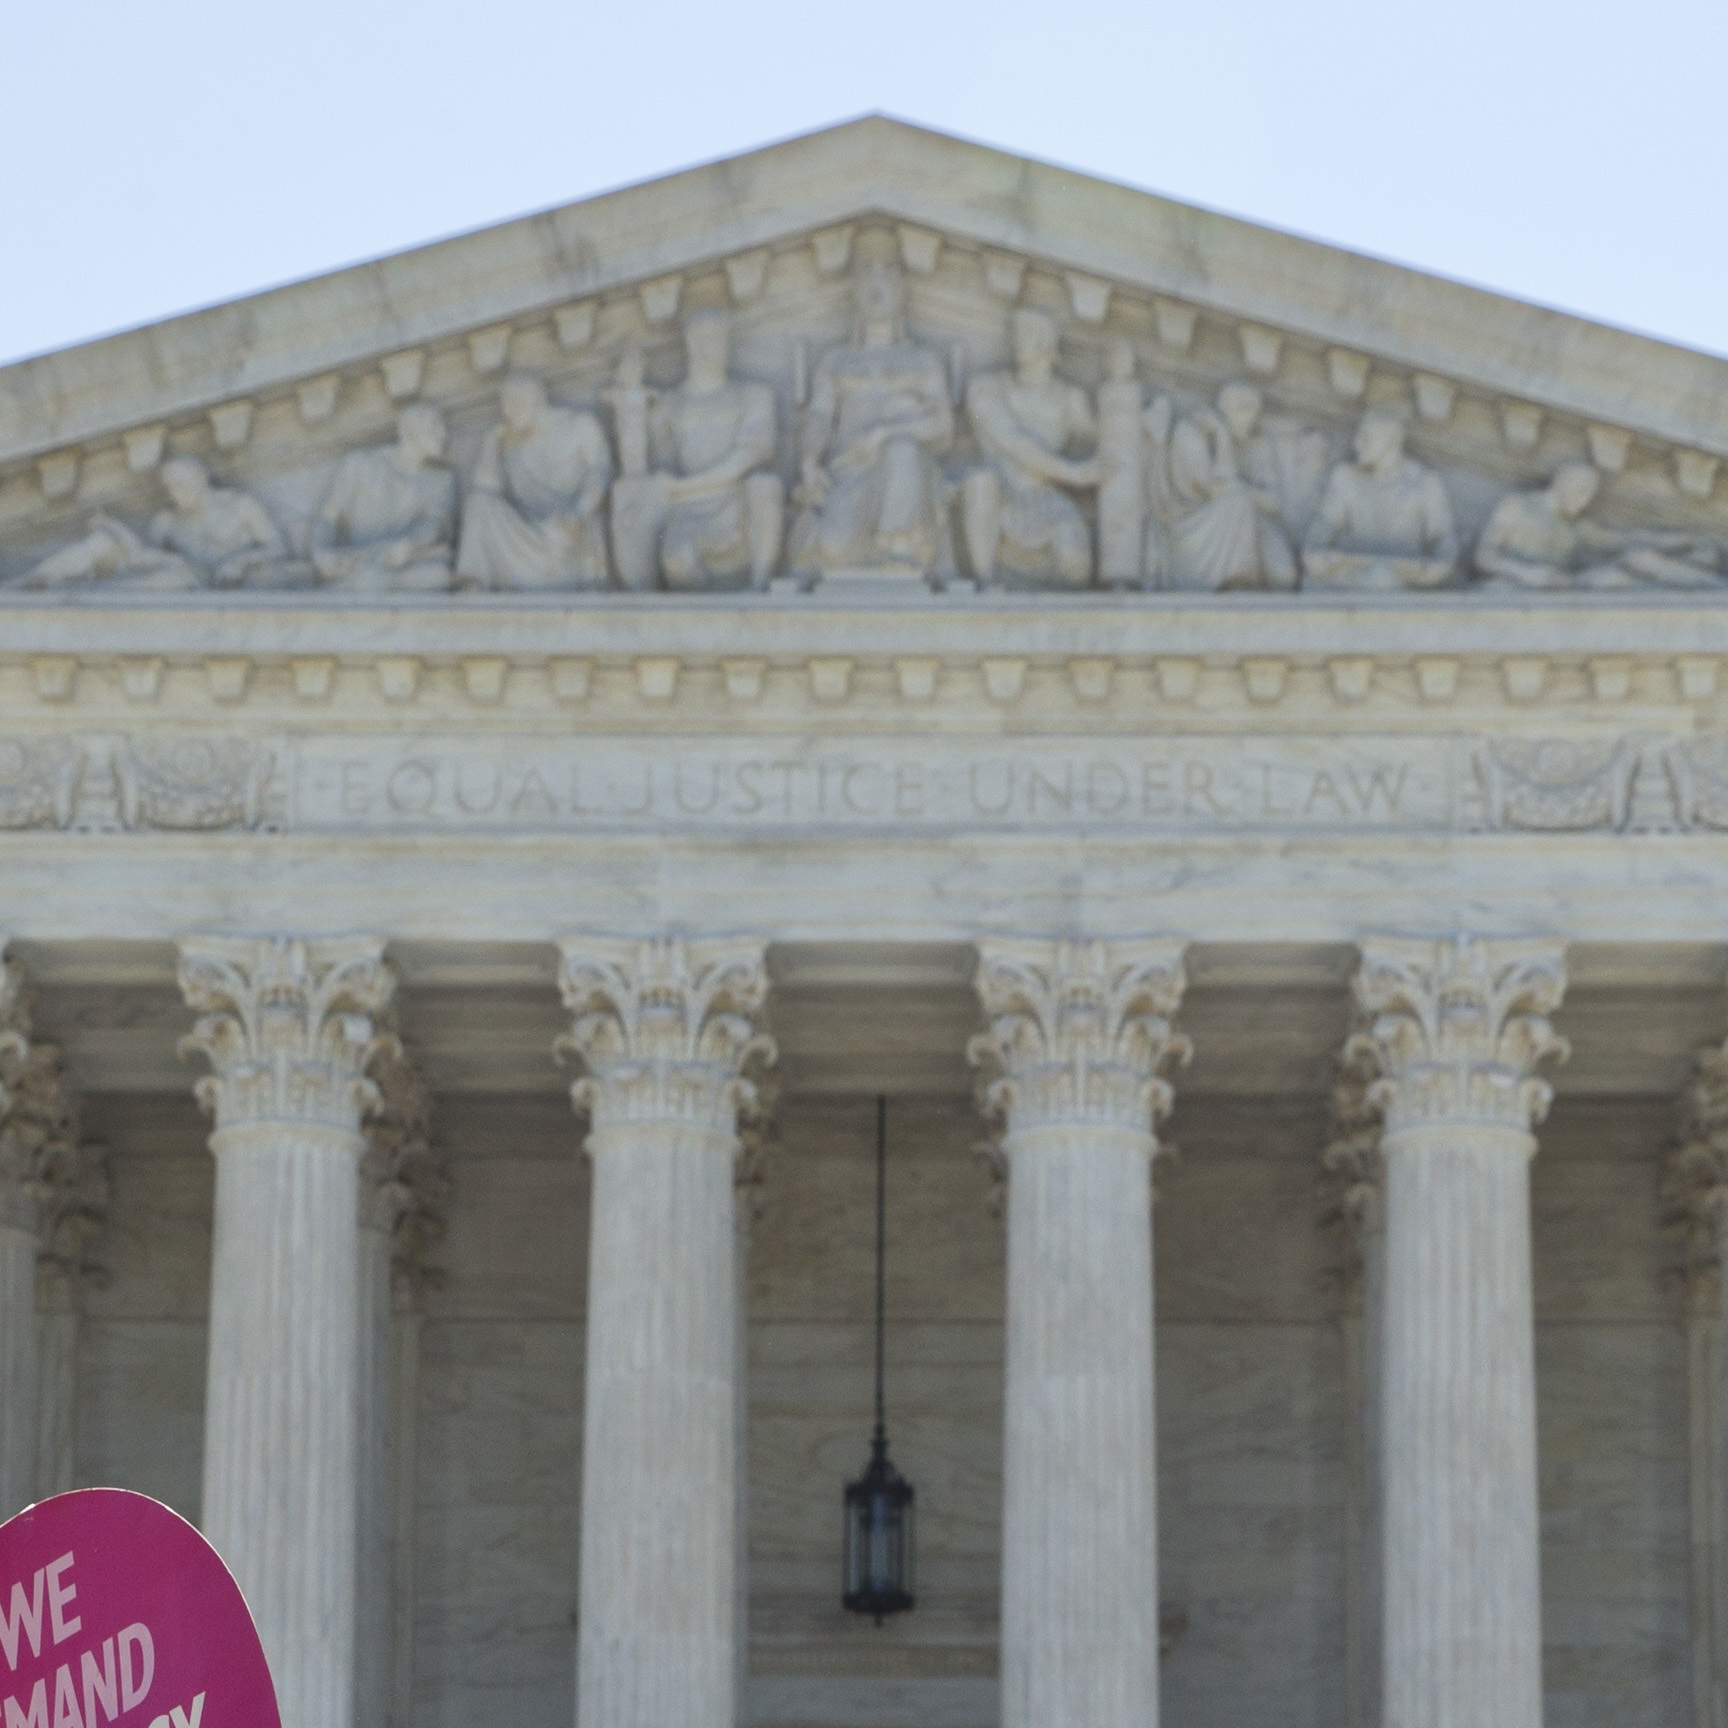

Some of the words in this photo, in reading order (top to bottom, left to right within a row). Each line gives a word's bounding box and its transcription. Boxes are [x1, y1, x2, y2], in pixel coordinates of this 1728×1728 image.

[338, 758, 590, 817] EQUAL
[621, 759, 926, 817] JUSTICE
[967, 759, 1234, 816] UNDER
[1260, 759, 1410, 816] LAW
